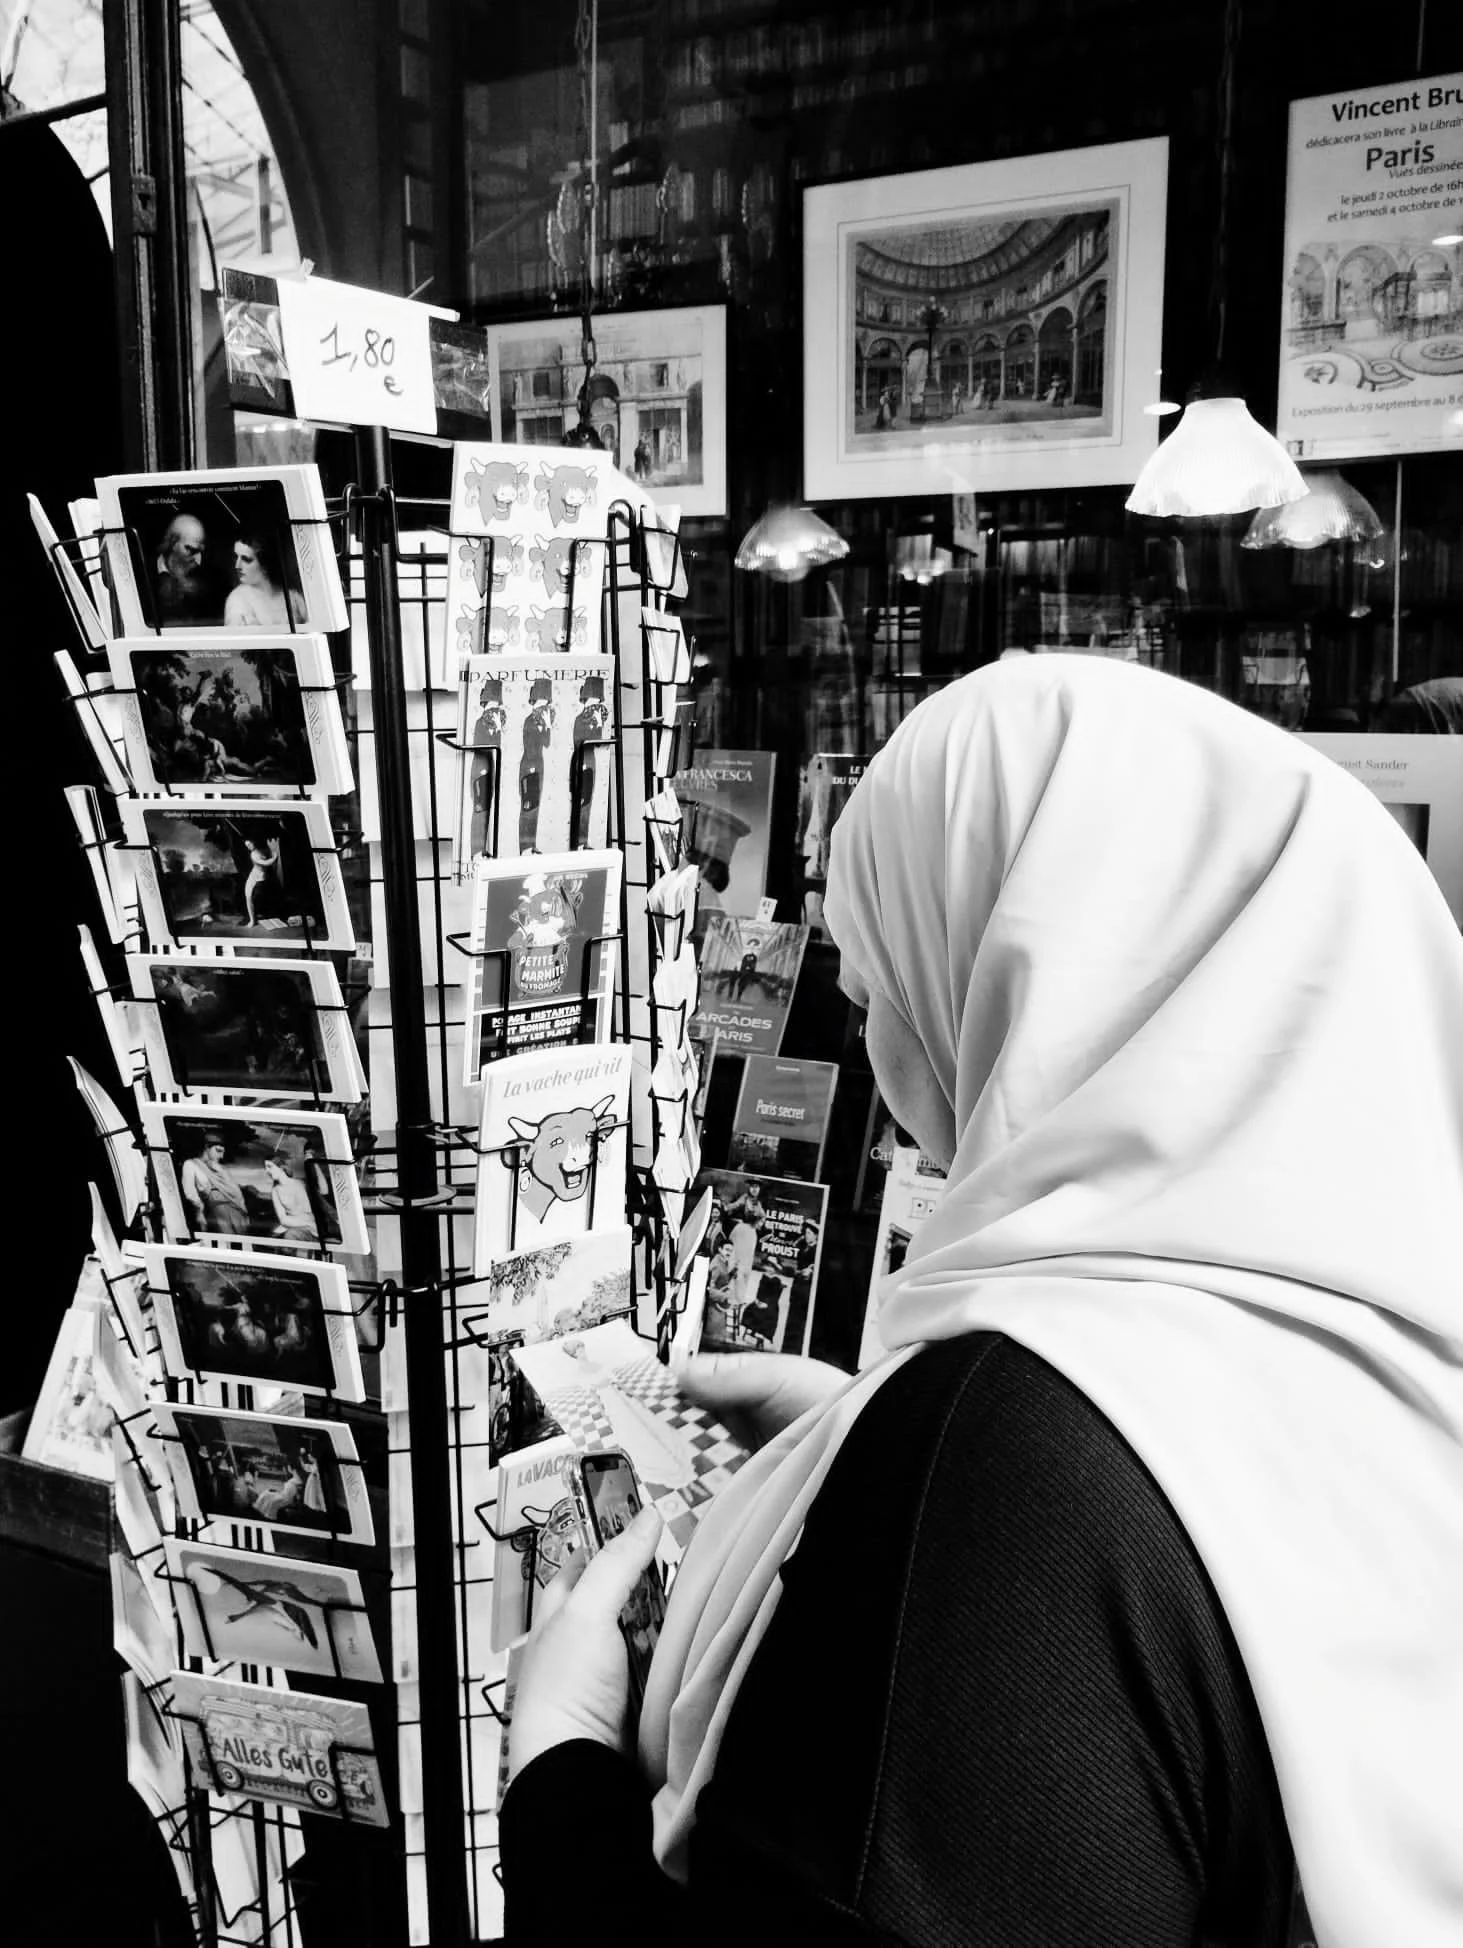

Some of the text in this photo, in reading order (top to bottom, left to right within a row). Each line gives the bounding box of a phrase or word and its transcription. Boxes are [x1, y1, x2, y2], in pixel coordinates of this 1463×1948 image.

[1332, 91, 1421, 122] Vincent
[1306, 134, 1361, 149] dédicacera
[1363, 129, 1383, 140] son
[1384, 126, 1406, 137] livre
[1366, 140, 1435, 171] Paris
[1352, 191, 1377, 206] jeudi
[1387, 184, 1428, 198] octobre
[1430, 182, 1444, 193] de
[1327, 212, 1338, 223] et
[1351, 205, 1388, 219] samedi
[1390, 207, 1397, 216] 4
[1399, 198, 1440, 213] octobre
[1442, 197, 1456, 208] de
[320, 321, 395, 372] 1,80
[469, 669, 609, 682] PARFUMERIE
[1366, 759, 1408, 770] Sander
[519, 954, 554, 967] PETITE
[553, 1016, 581, 1030] SOUP
[695, 1011, 773, 1030] ARCADES
[525, 1069, 573, 1093] vache
[574, 1060, 601, 1086] qui
[755, 1098, 805, 1120] Paris secret
[766, 1208, 805, 1224] LE PARIS
[761, 1242, 801, 1257] PROUST
[223, 1736, 329, 1778] Alles Gute
